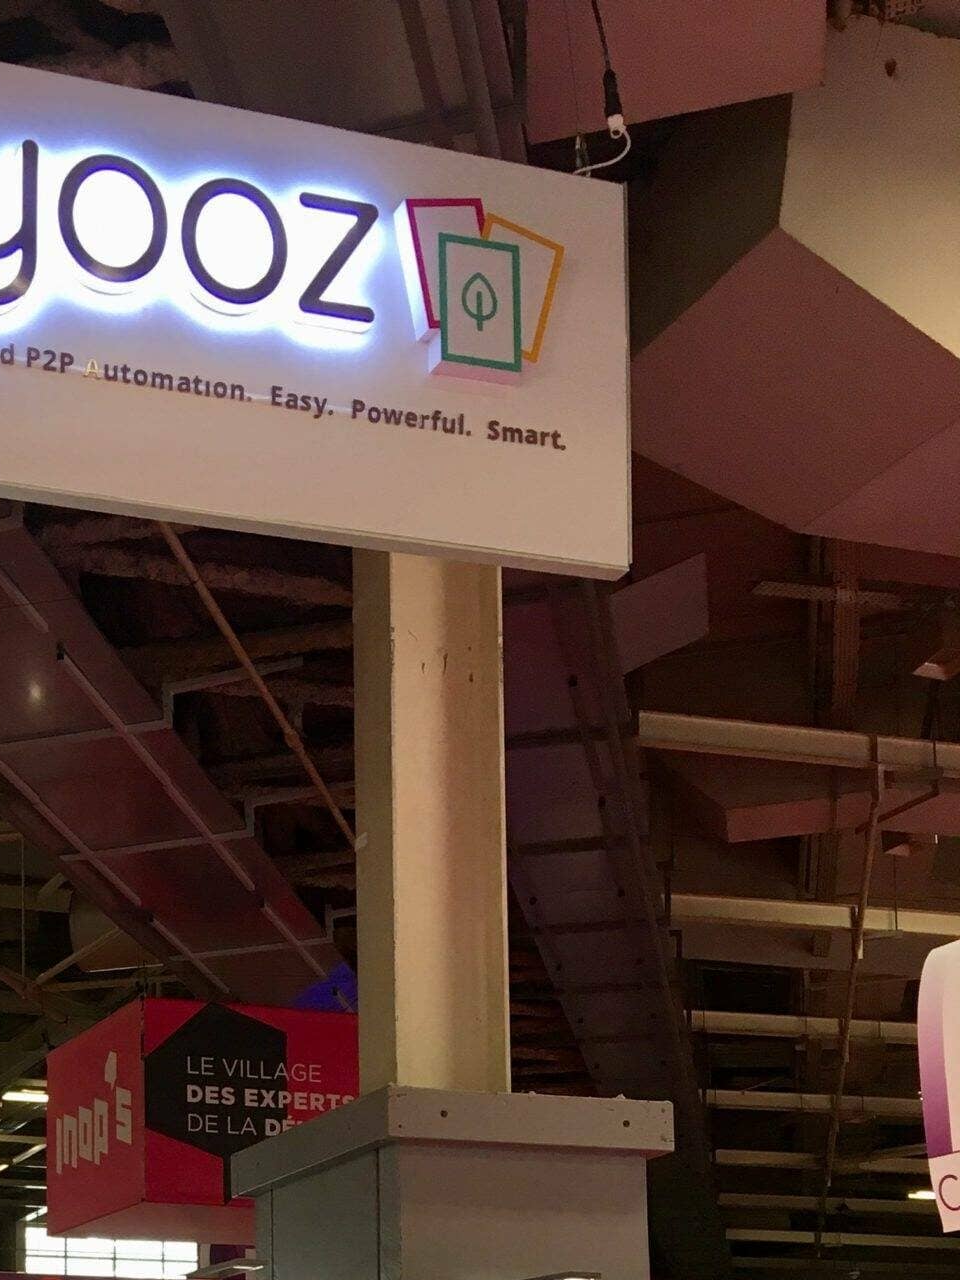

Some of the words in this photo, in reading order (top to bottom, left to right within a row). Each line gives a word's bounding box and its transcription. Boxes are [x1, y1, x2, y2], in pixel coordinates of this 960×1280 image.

[26, 346, 74, 373] P2P
[83, 358, 252, 402] Automation.
[270, 385, 334, 419] Easy.
[351, 399, 472, 436] Powerful.
[487, 420, 567, 451] Smart.
[186, 1056, 214, 1076] LE
[222, 1058, 322, 1083] VILLAGE
[186, 1084, 235, 1106] DES
[188, 1113, 218, 1133] DE
[227, 1116, 257, 1136] LA
